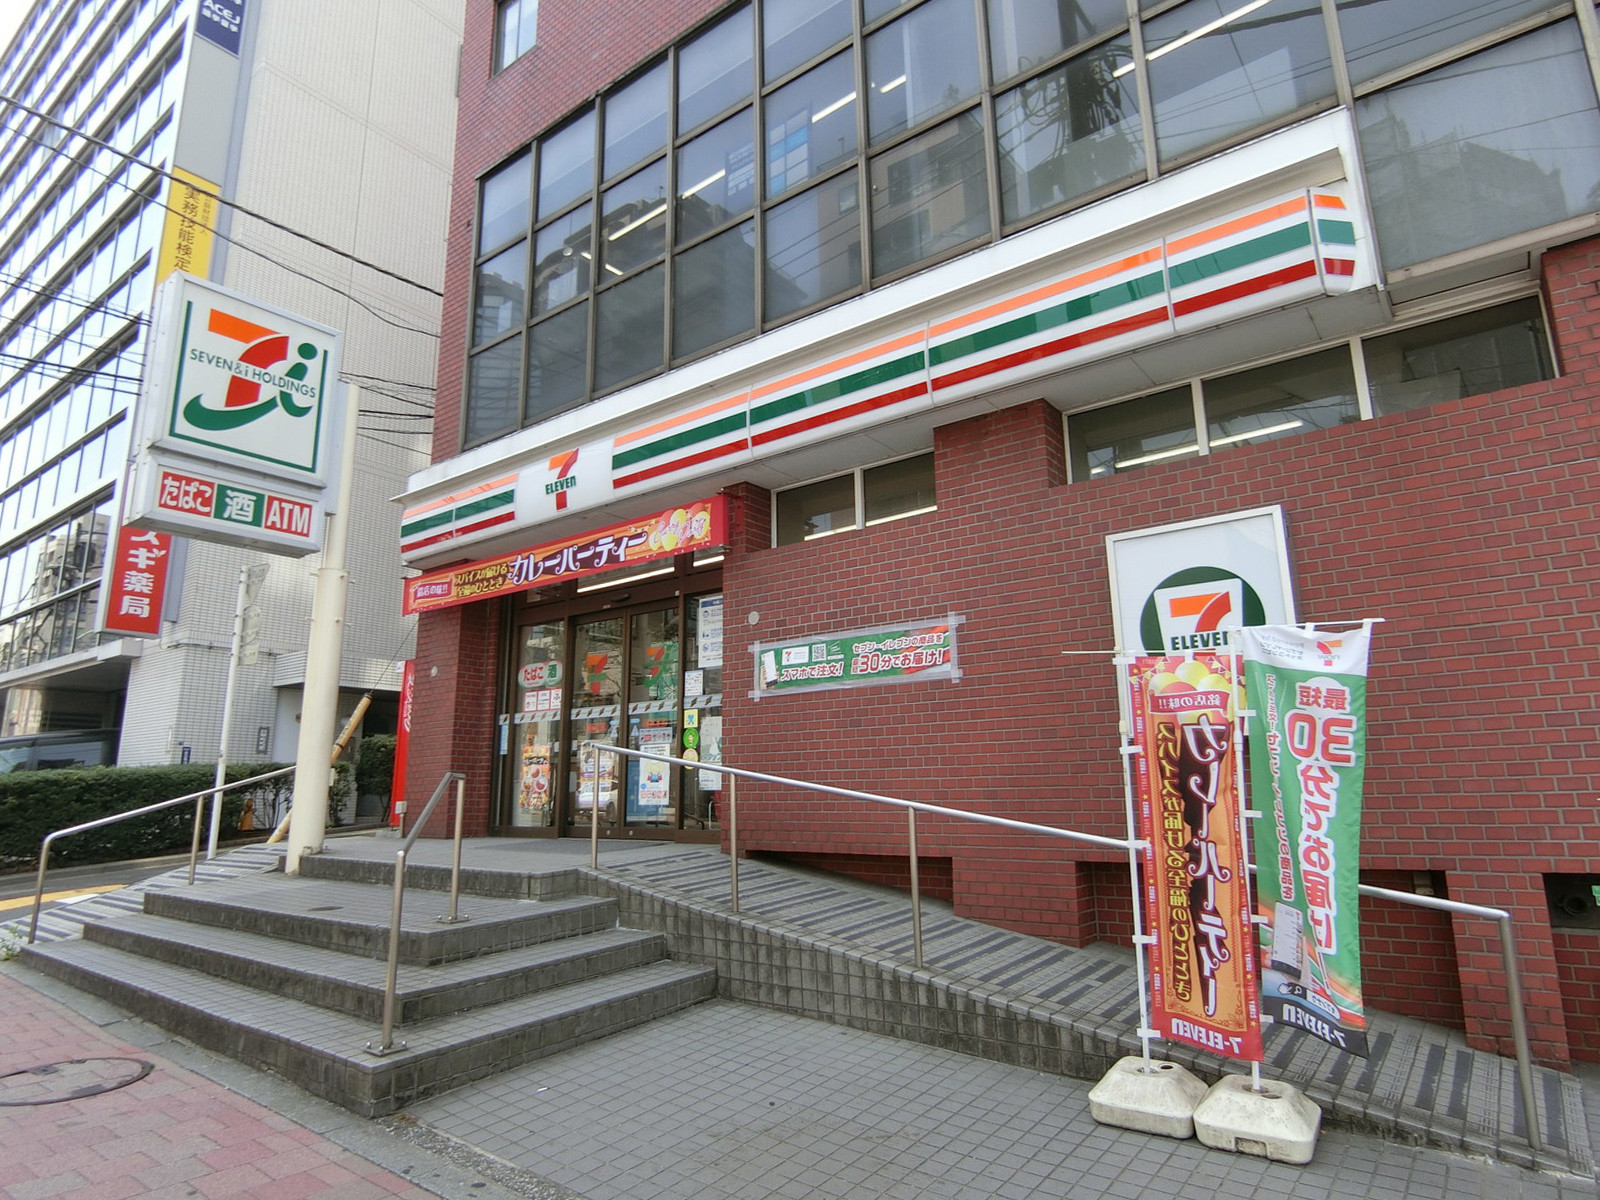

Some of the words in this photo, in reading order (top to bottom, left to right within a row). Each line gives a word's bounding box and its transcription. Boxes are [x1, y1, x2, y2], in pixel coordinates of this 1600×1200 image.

[251, 368, 317, 399] HOLDINGS
[161, 475, 212, 514] たばこ
[223, 489, 257, 523] 酒
[267, 500, 310, 536] ATM
[507, 531, 649, 585] カレーパーティー
[523, 665, 544, 682] たばこ
[547, 663, 558, 679] 酒
[780, 662, 844, 681] スマホで注文!
